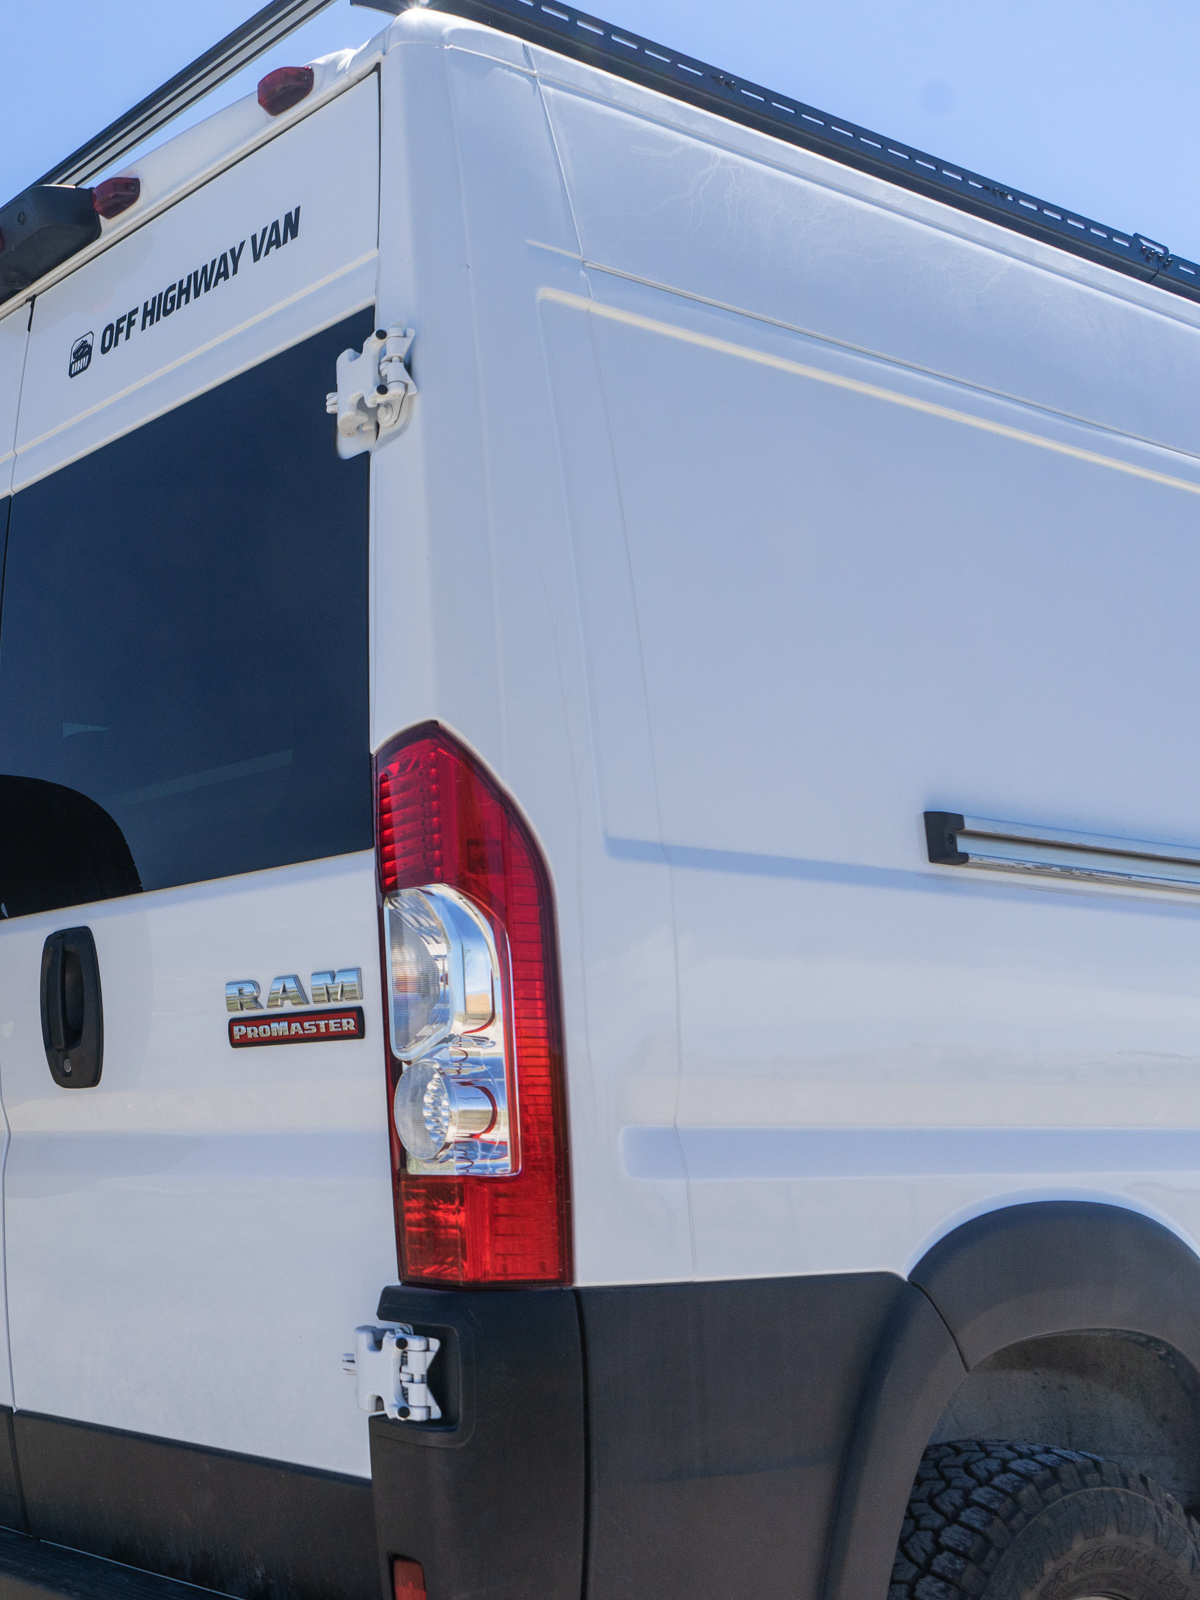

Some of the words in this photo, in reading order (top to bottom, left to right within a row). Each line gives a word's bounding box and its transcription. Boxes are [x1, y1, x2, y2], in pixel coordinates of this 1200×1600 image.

[100, 306, 139, 355] OFF
[141, 240, 247, 331] HIGHWAY
[250, 205, 301, 263] VAN
[225, 967, 363, 1012] RAM
